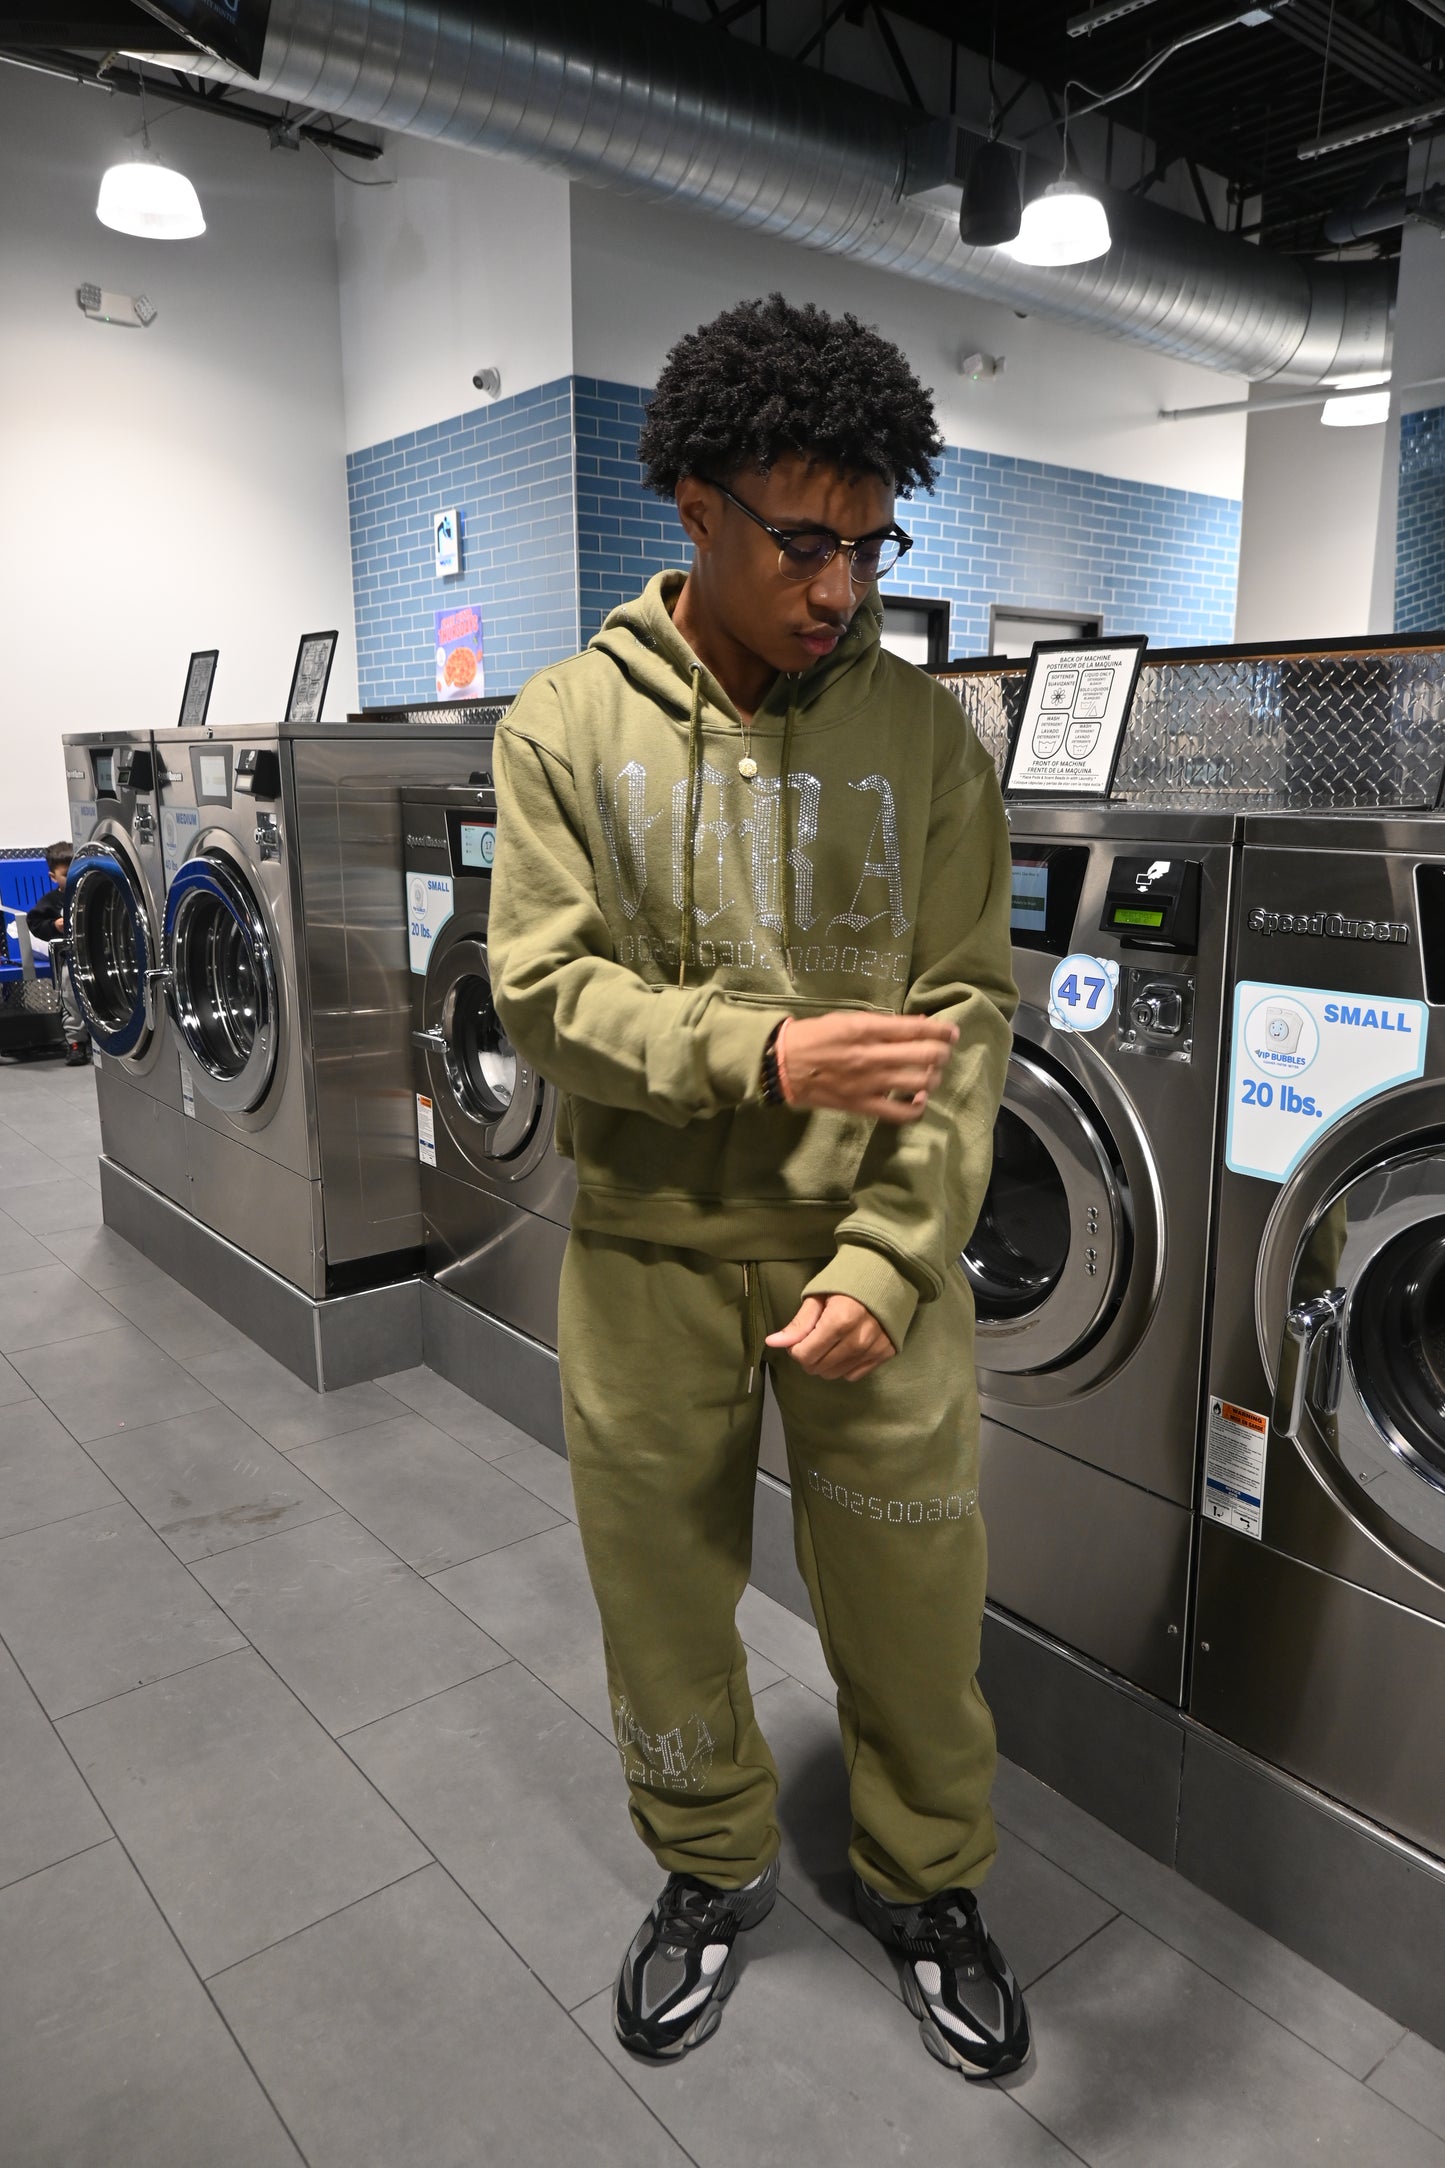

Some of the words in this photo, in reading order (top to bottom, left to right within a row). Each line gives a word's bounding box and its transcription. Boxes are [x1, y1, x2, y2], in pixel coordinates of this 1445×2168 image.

[1084, 654, 1111, 662] MACHINE
[1095, 661, 1122, 669] MAQUINA
[80, 806, 96, 817] MEDIUM
[175, 812, 197, 826] MEDIUM
[593, 760, 913, 938] VERA
[427, 880, 449, 893] SMALL
[411, 922, 419, 937] 20
[420, 924, 432, 938] lbs.
[1057, 973, 1106, 1010] 47
[1323, 1003, 1412, 1033] SMALL
[1257, 1051, 1270, 1060] VIP
[1271, 1053, 1306, 1066] BUBBLES
[1241, 1079, 1273, 1108] 20
[1280, 1084, 1323, 1118] lbs.
[1232, 1408, 1263, 1424] WARNING
